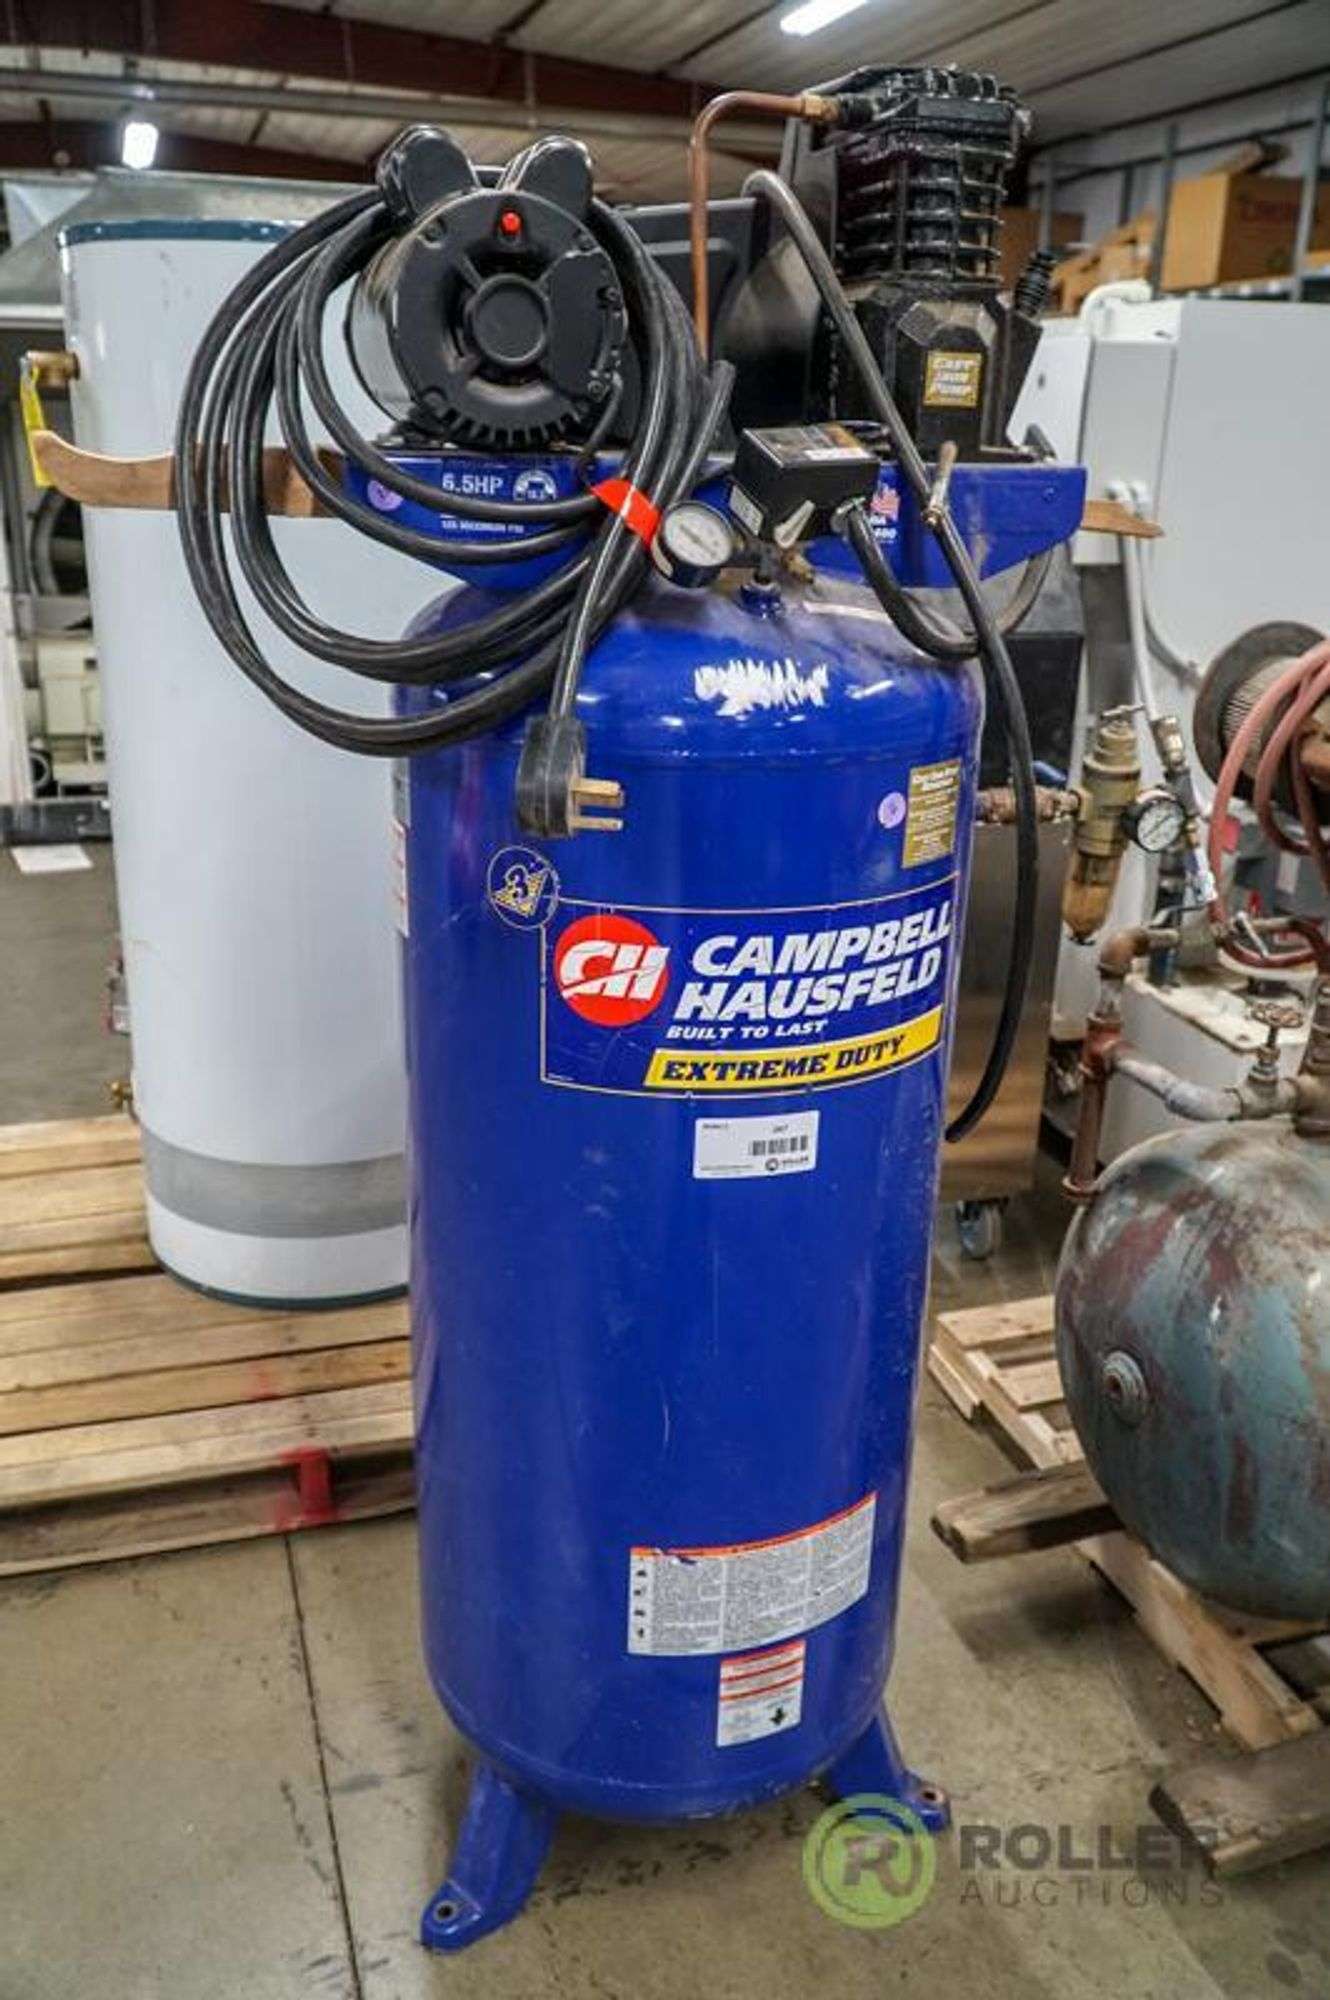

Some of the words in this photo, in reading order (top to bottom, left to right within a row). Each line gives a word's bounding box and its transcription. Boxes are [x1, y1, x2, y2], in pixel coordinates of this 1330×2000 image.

[442, 472, 503, 495] 6.5HP
[692, 901, 950, 976] CAMPBELL
[560, 939, 672, 1001] CH
[673, 947, 942, 1021] HAUSFELD
[666, 1024, 734, 1040] BUILT
[741, 1025, 769, 1039] TO
[774, 1018, 829, 1037] LAST
[662, 1053, 833, 1081] EXTREME
[835, 1033, 906, 1069] DUTY
